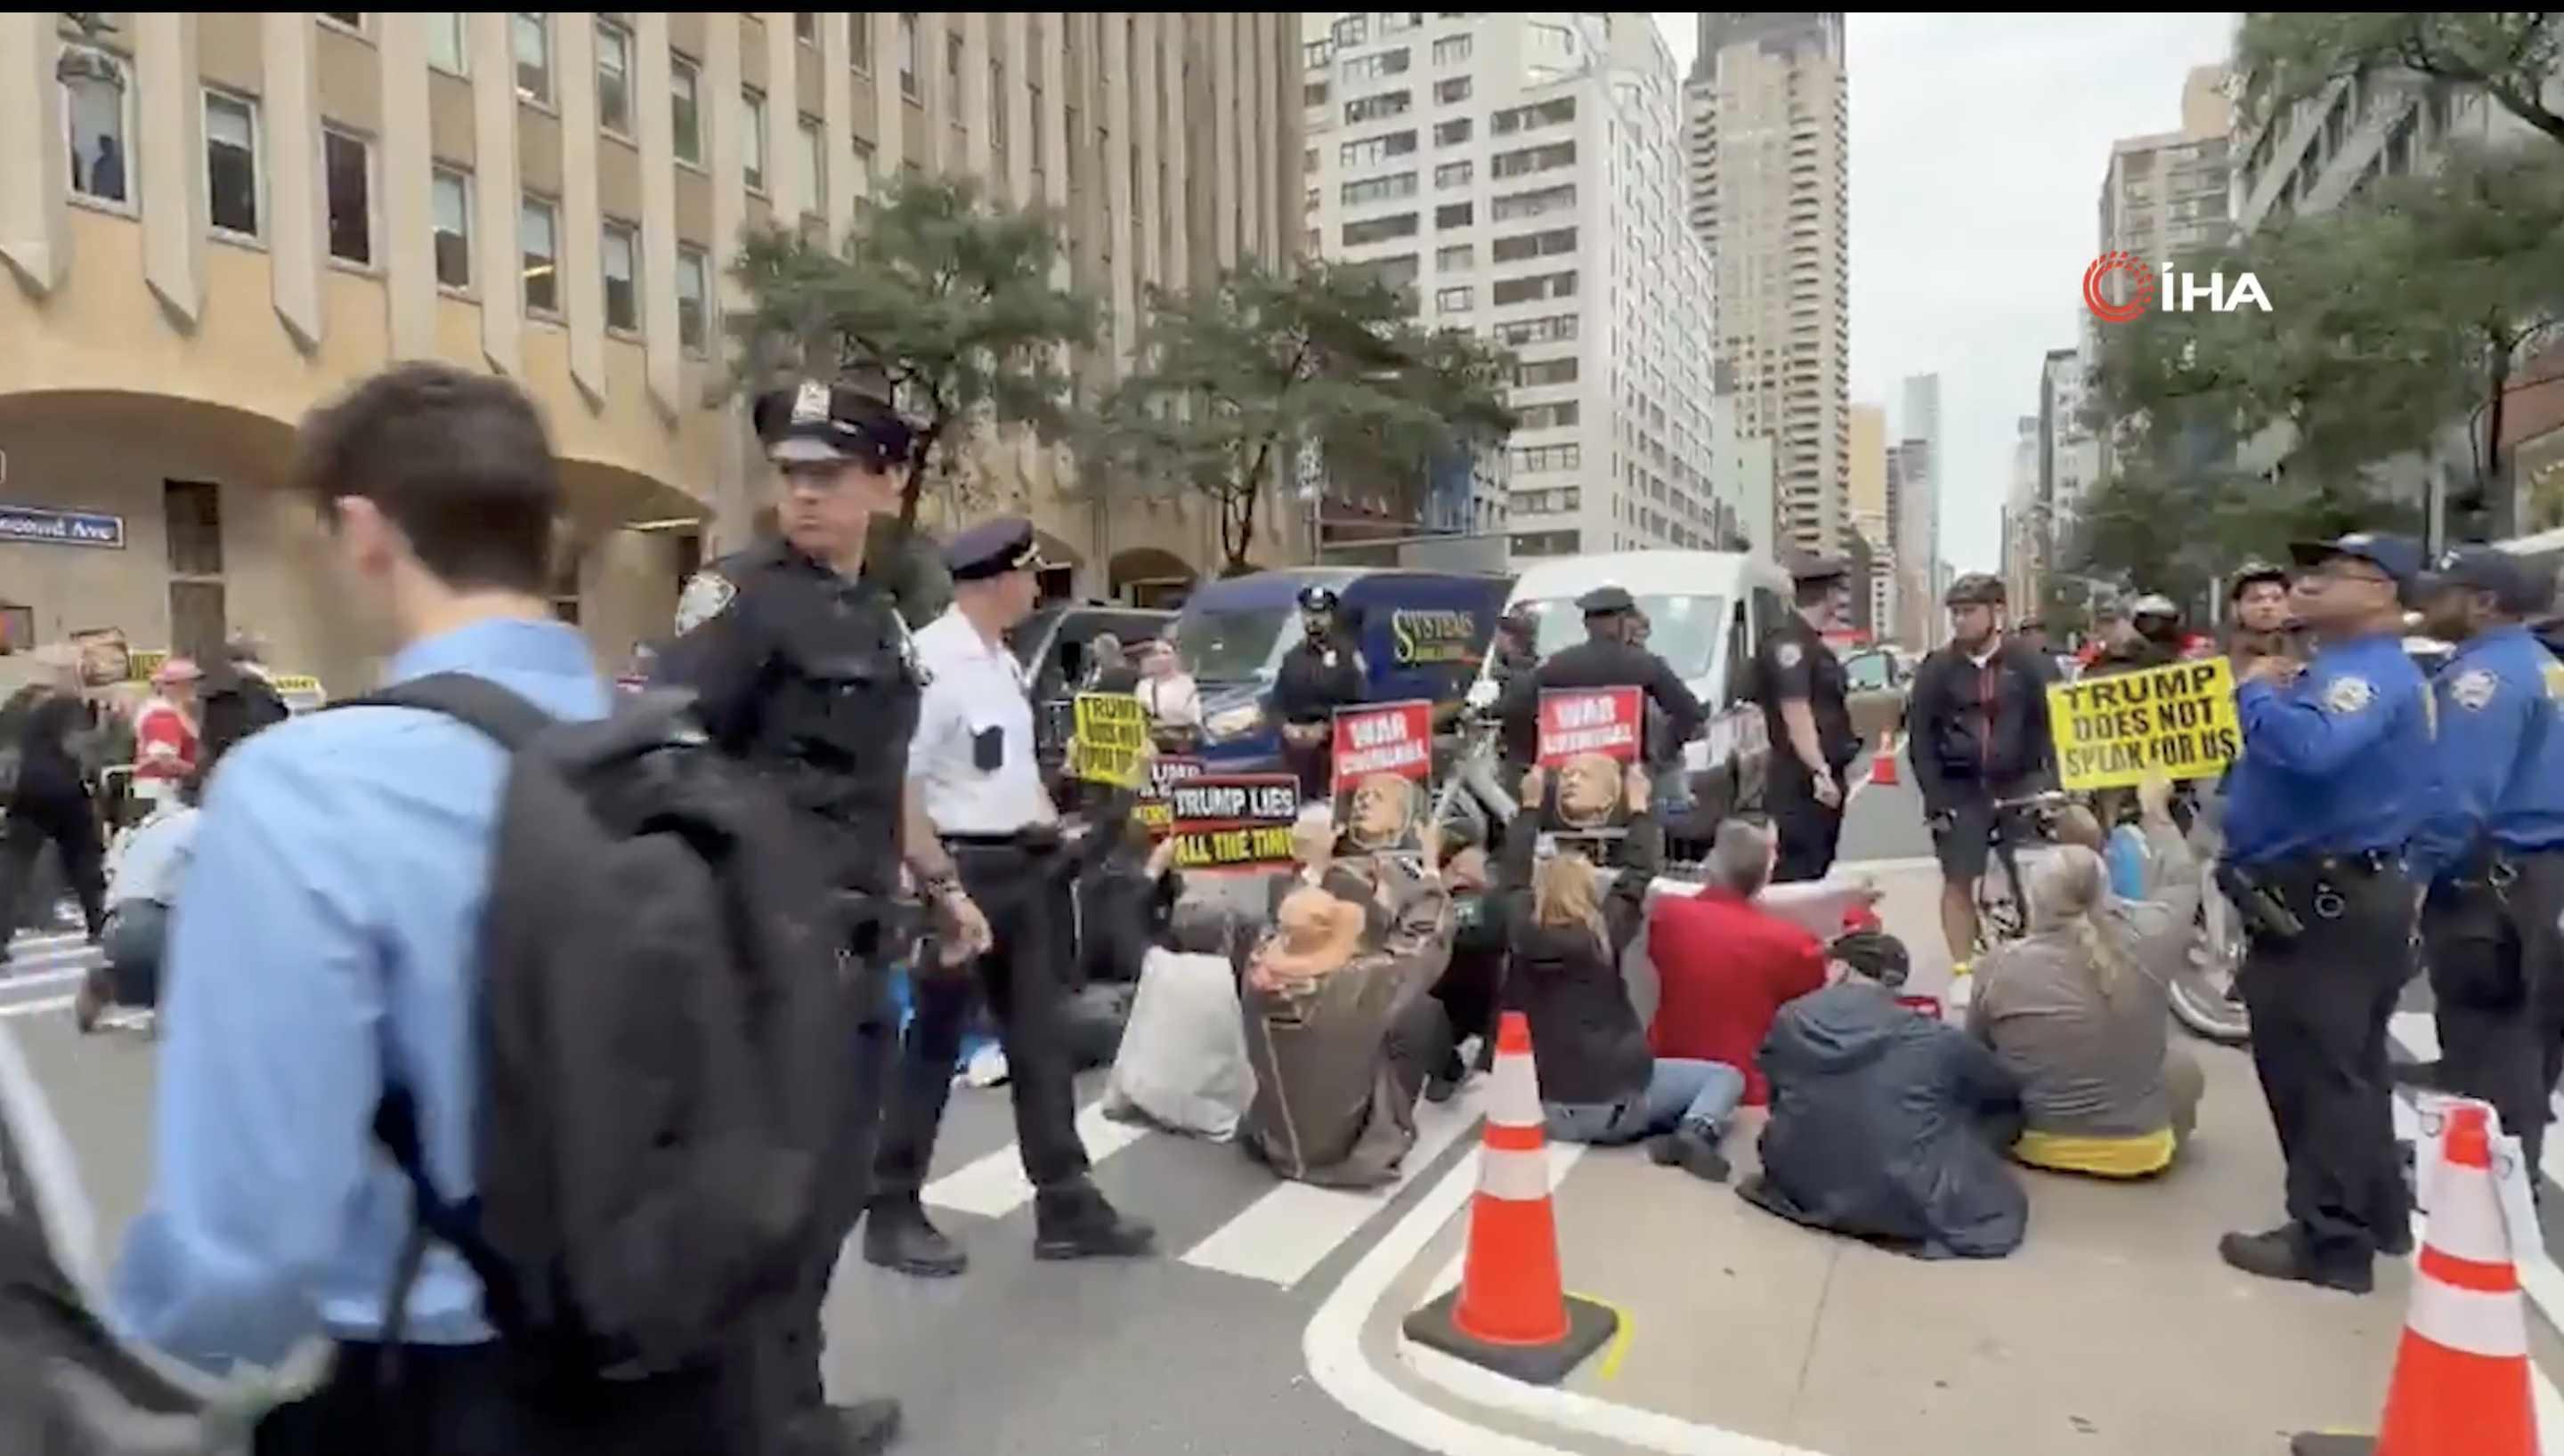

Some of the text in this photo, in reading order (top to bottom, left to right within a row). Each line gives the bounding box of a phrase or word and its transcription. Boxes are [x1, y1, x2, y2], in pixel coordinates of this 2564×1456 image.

[0, 518, 65, 536] econd
[2061, 666, 2215, 709] TRUMP
[1552, 696, 1616, 728] WAR
[2074, 697, 2212, 741] DOES NOT
[1348, 712, 1408, 749] WAR
[2201, 729, 2235, 760] US
[1152, 763, 1201, 781] UMP
[1174, 786, 1246, 816] TRUMP
[1250, 785, 1294, 816] LIES
[1175, 834, 1212, 865] ALL
[1213, 829, 1251, 861] THE
